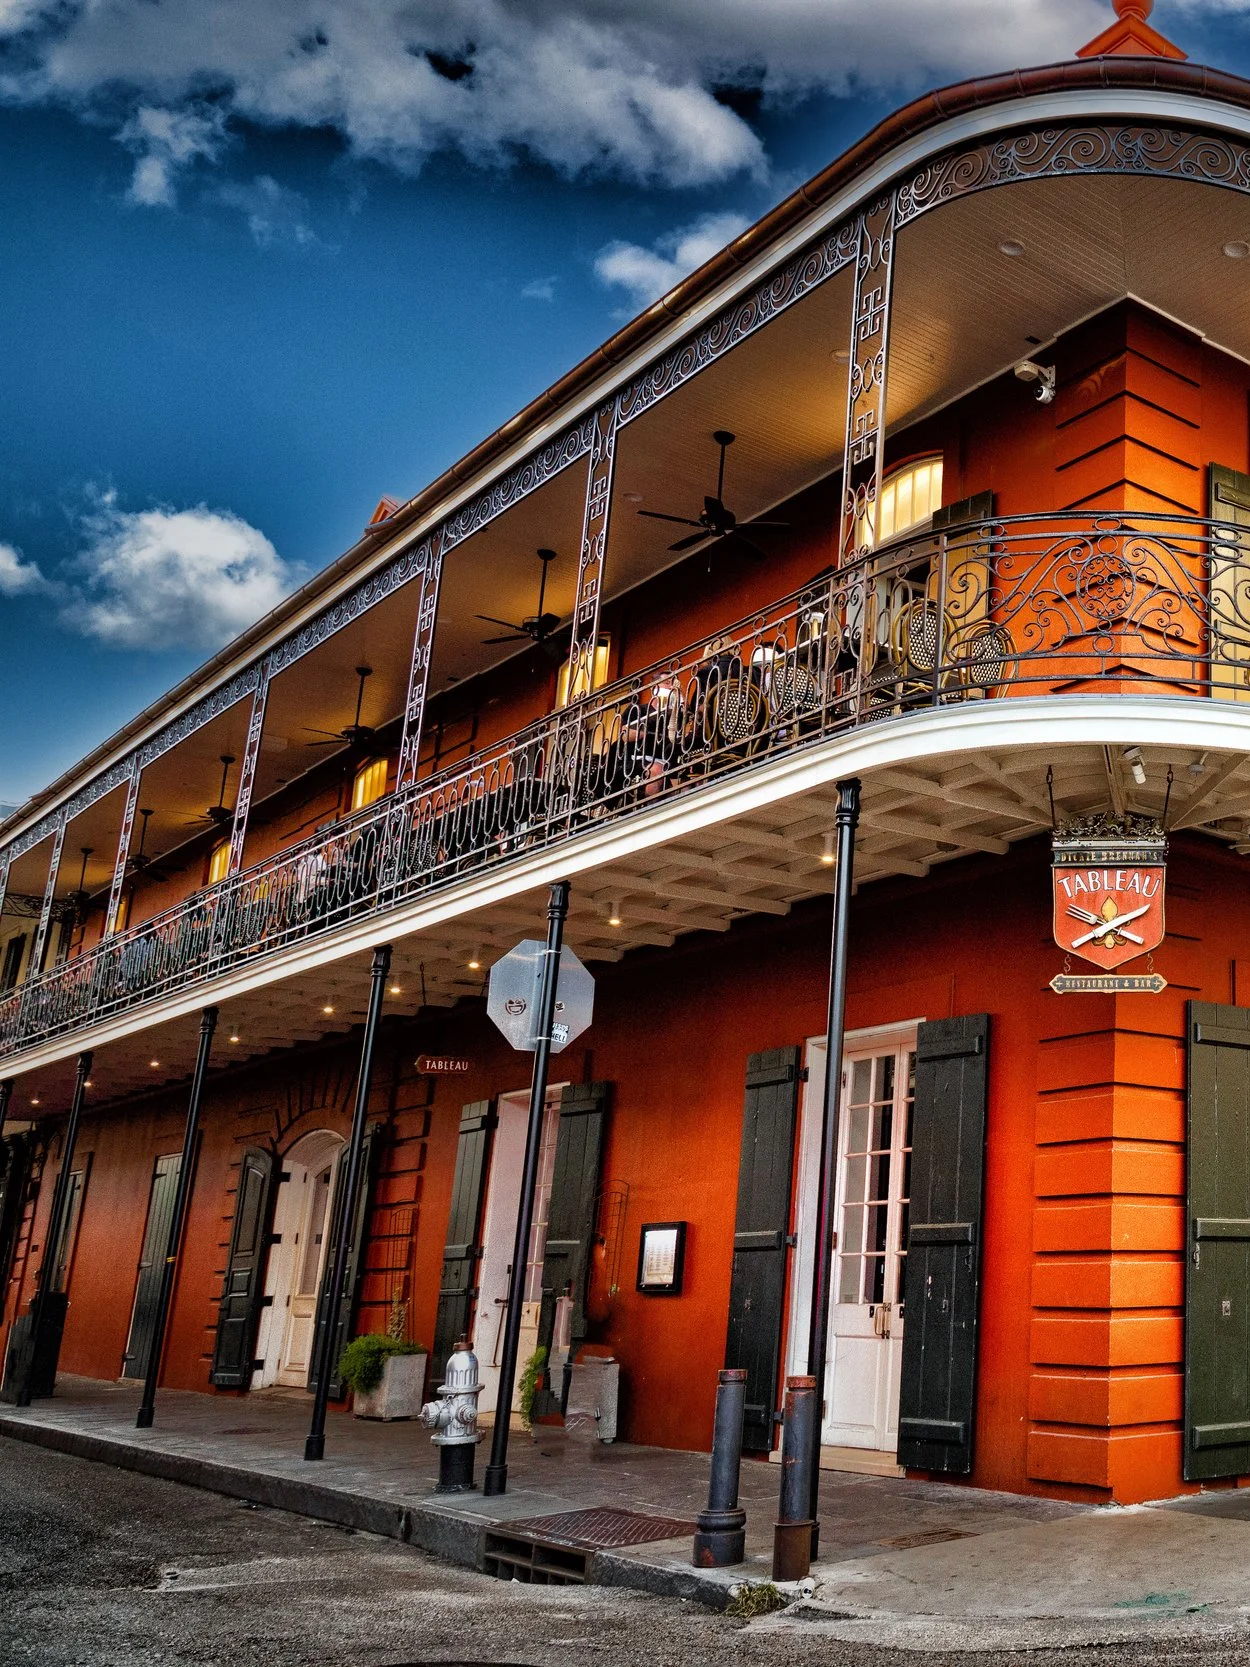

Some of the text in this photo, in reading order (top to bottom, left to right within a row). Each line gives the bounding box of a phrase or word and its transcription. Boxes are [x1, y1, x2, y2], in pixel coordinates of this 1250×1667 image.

[1057, 869, 1160, 898] TABLEAU
[1065, 979, 1151, 988] RESTAURANT & BAR
[426, 1060, 469, 1071] TABLEAU
